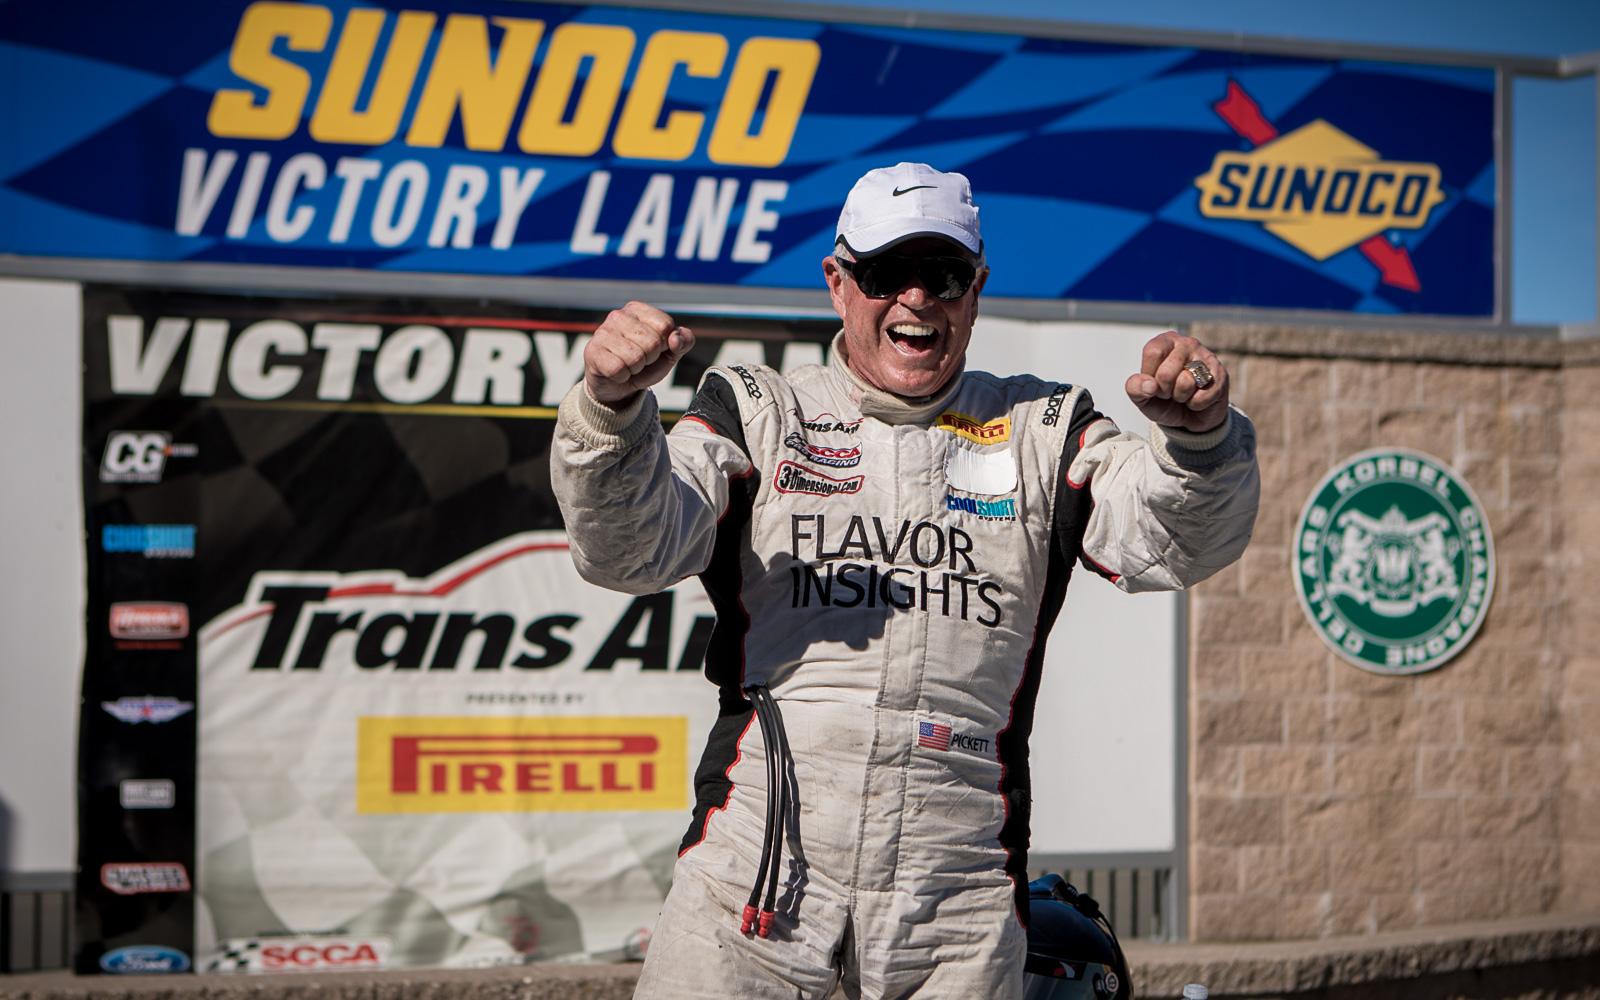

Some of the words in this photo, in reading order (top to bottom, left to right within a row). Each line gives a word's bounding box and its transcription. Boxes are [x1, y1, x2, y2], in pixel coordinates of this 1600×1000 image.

[207, 1, 821, 168] SUNOCO
[175, 147, 546, 252] VICTORY
[571, 171, 790, 264] LANE
[1211, 162, 1431, 218] SUNOCO
[106, 315, 594, 407] VICTORY
[104, 432, 168, 474] CG
[807, 443, 861, 459] SCCA
[941, 413, 1006, 439] PIRELLI
[791, 513, 978, 574] FLAVOR
[790, 561, 1003, 628] INSIGHTS
[249, 584, 582, 671] Trans
[391, 734, 661, 795] PIRELLI
[950, 732, 990, 753] PICKETT
[260, 942, 379, 968] SCCA
